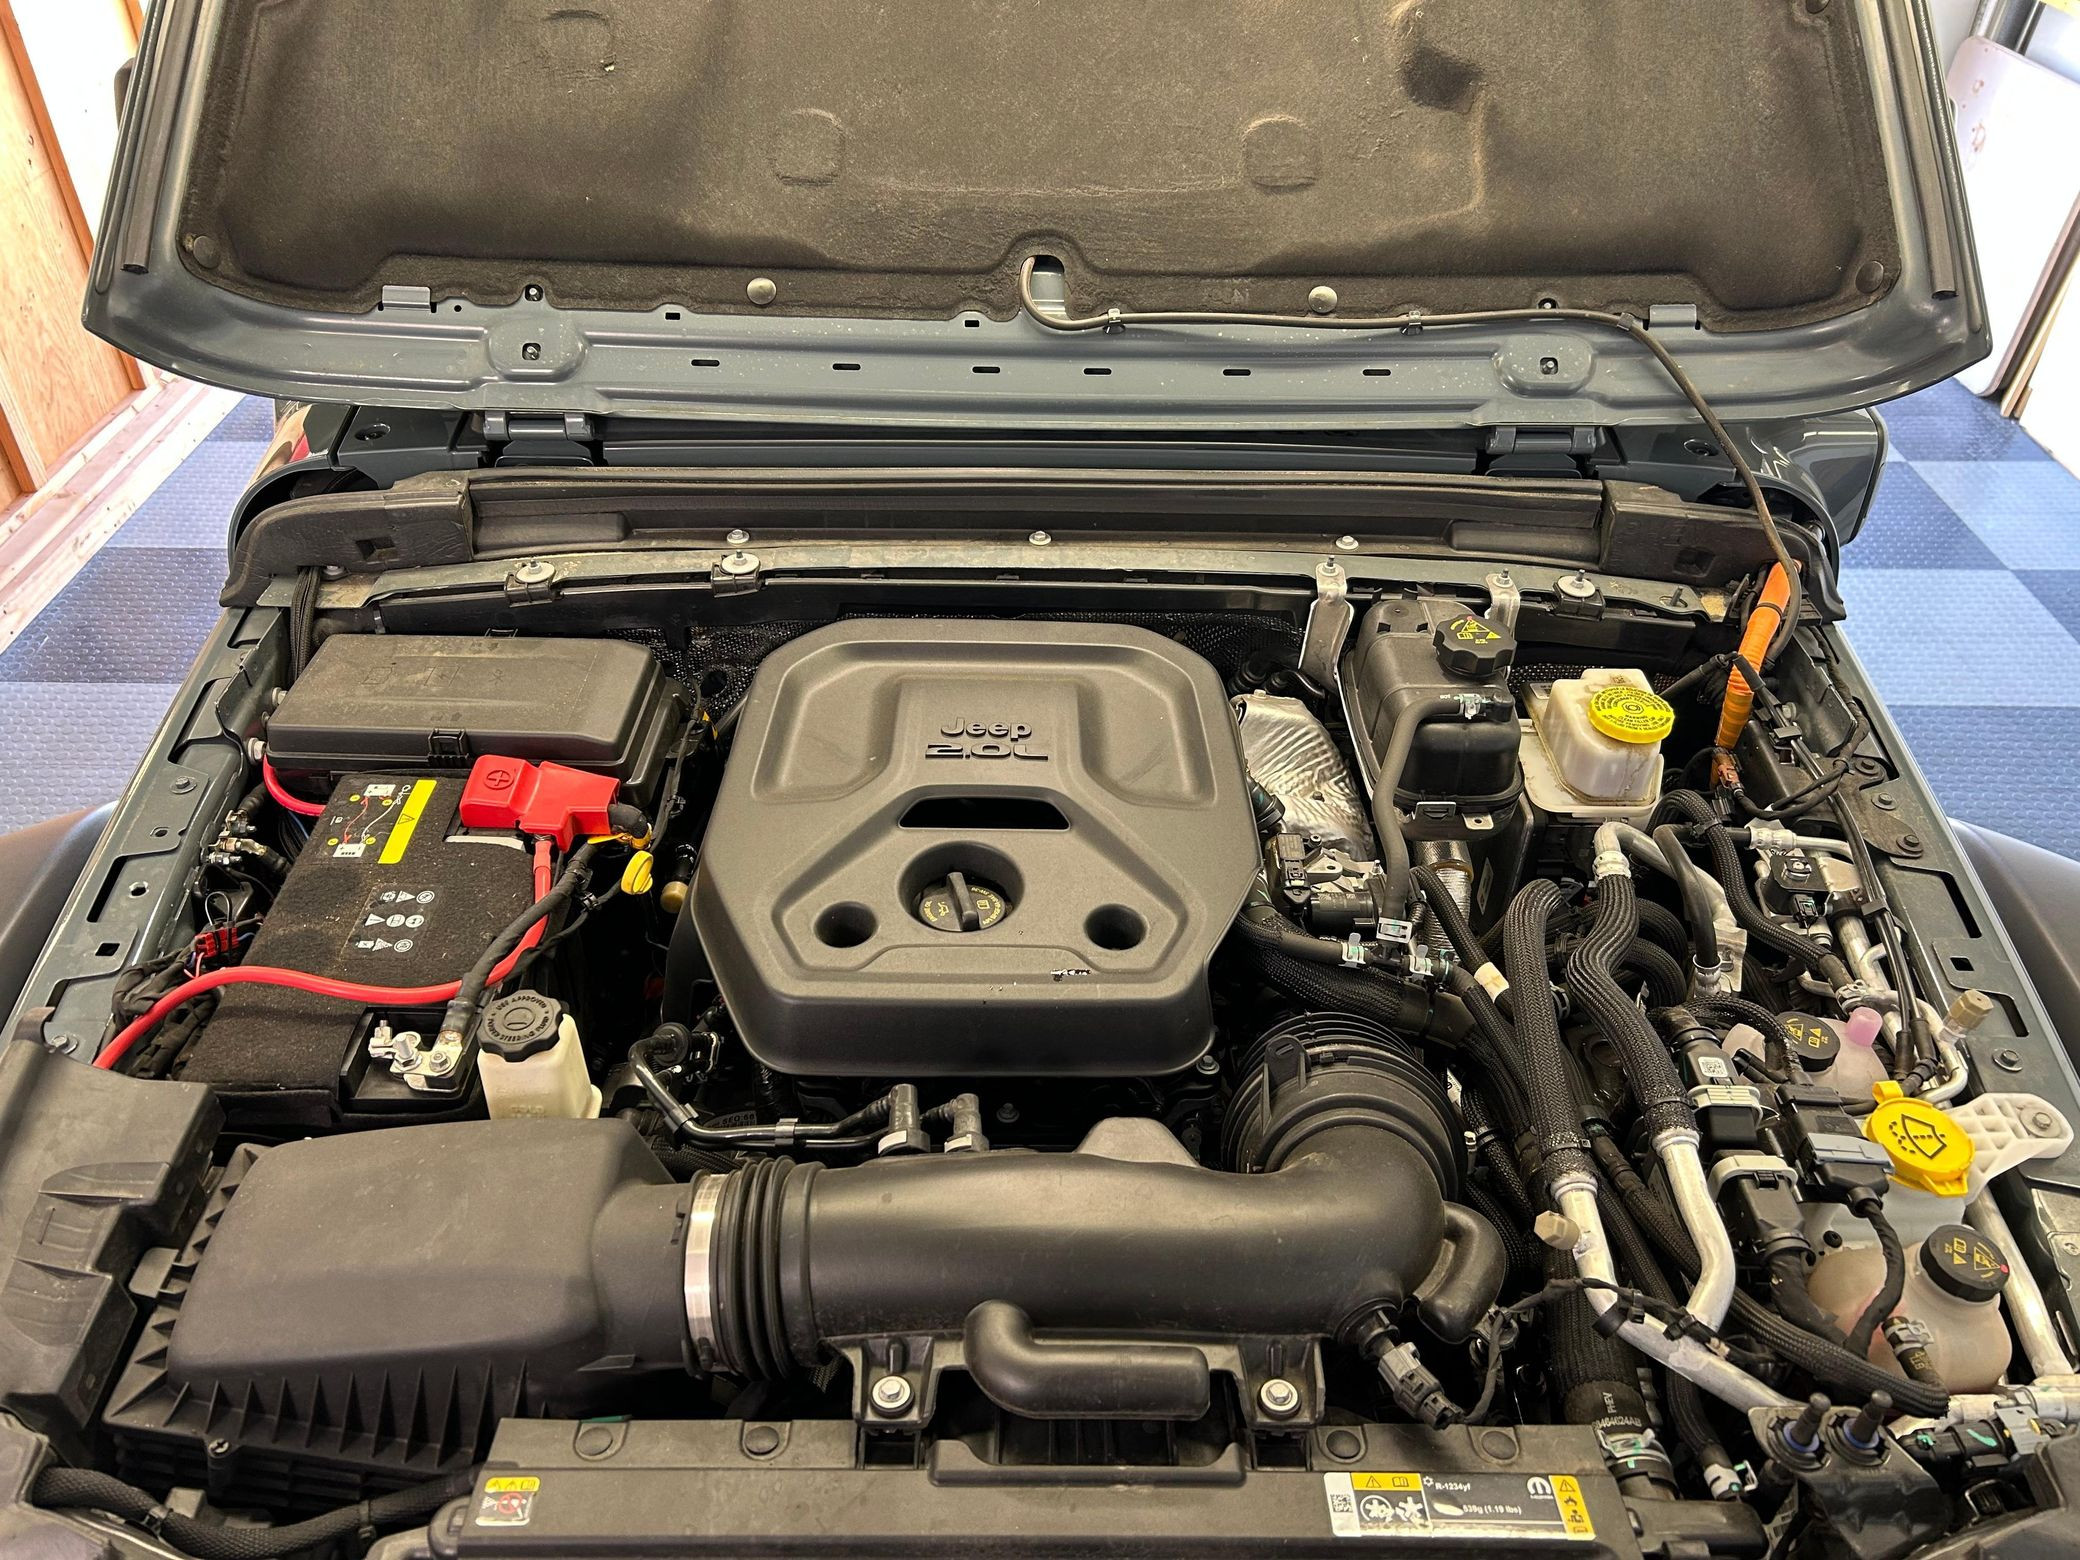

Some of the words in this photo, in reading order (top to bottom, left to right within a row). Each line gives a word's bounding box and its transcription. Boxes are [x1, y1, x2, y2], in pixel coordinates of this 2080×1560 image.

[941, 717, 1032, 741] Jeep
[925, 743, 1048, 760] 2.0L
[511, 995, 548, 1010] APPROVED
[499, 1029, 536, 1042] STEERING
[1435, 1481, 1471, 1492] R-1234yf
